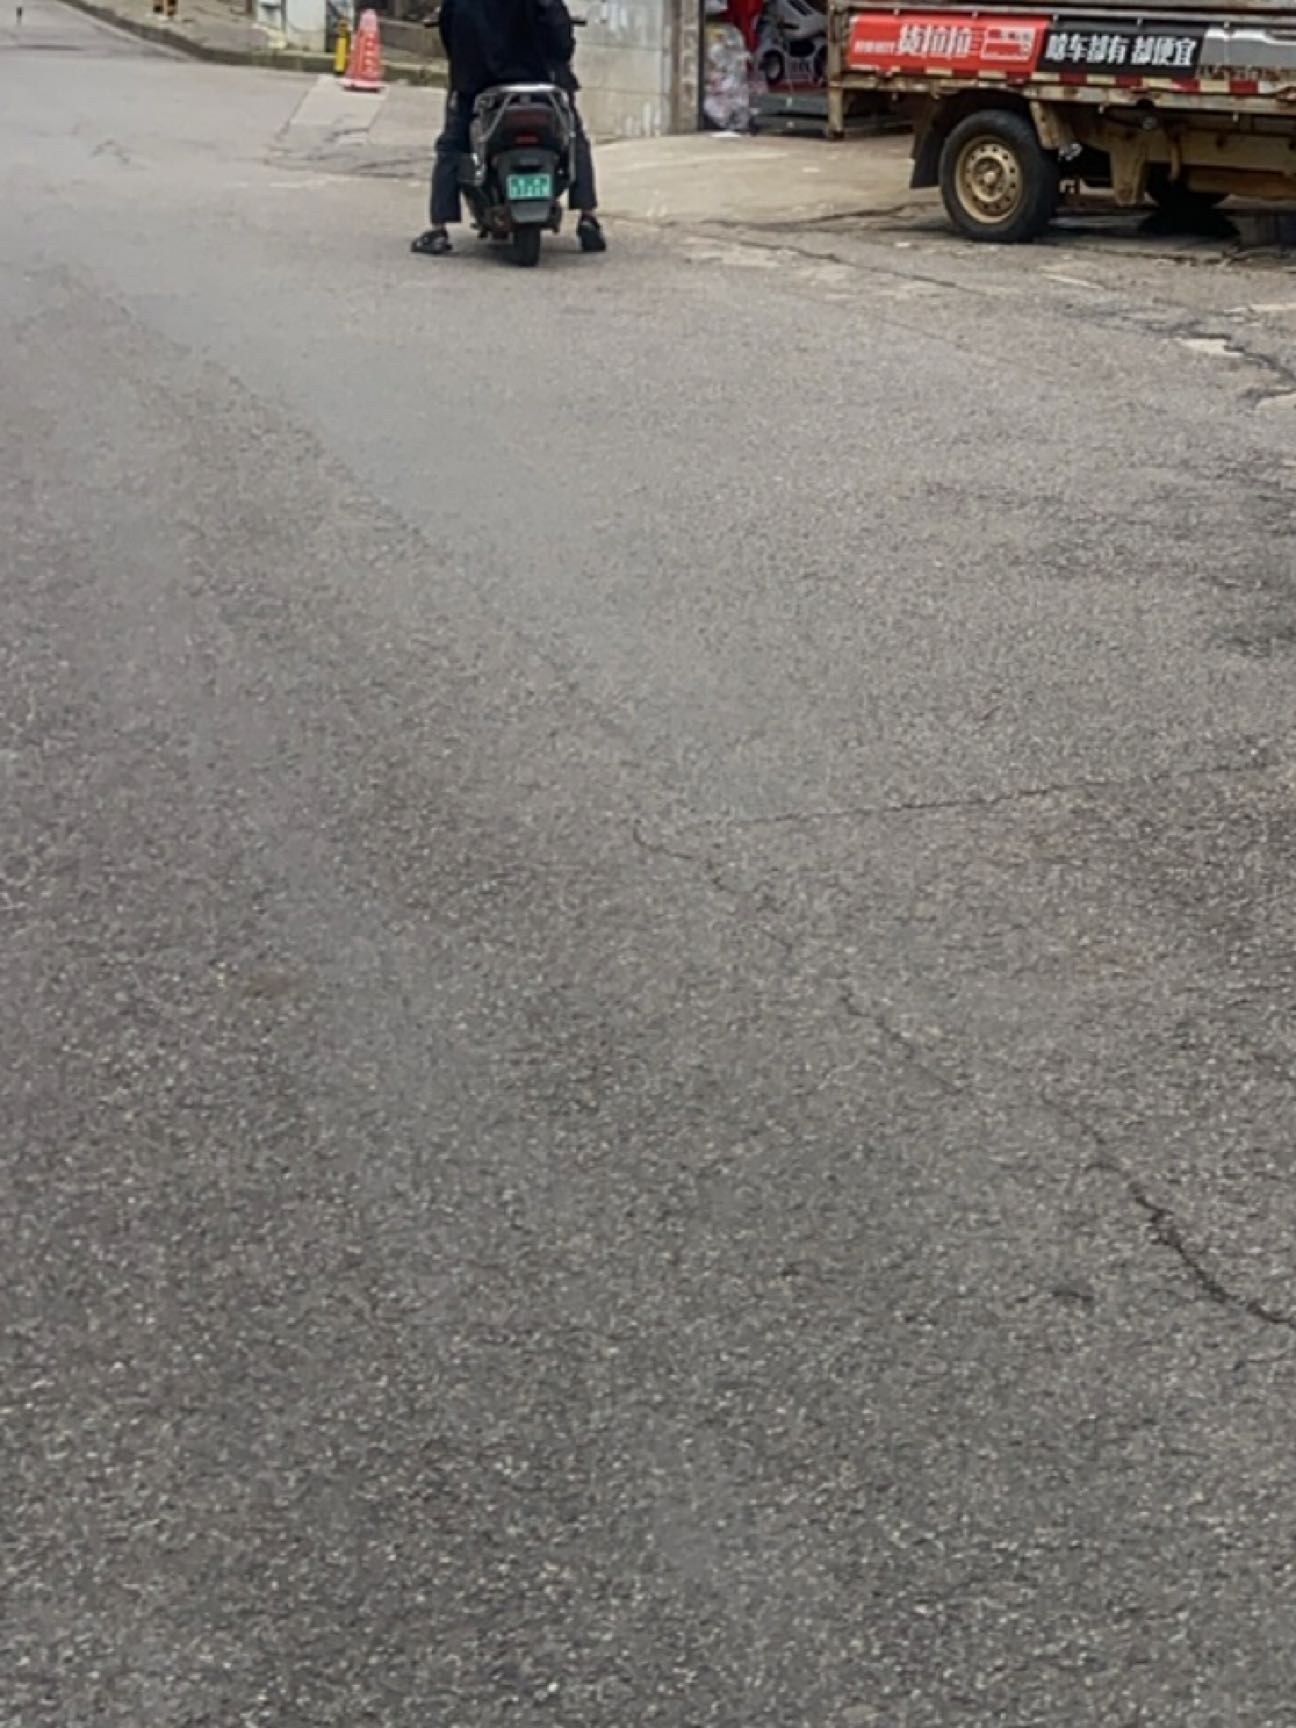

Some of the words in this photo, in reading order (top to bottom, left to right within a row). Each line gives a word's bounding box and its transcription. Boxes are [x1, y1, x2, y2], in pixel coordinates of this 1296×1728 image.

[899, 23, 974, 60] 货拉拉
[1131, 35, 1197, 66] 都便宜
